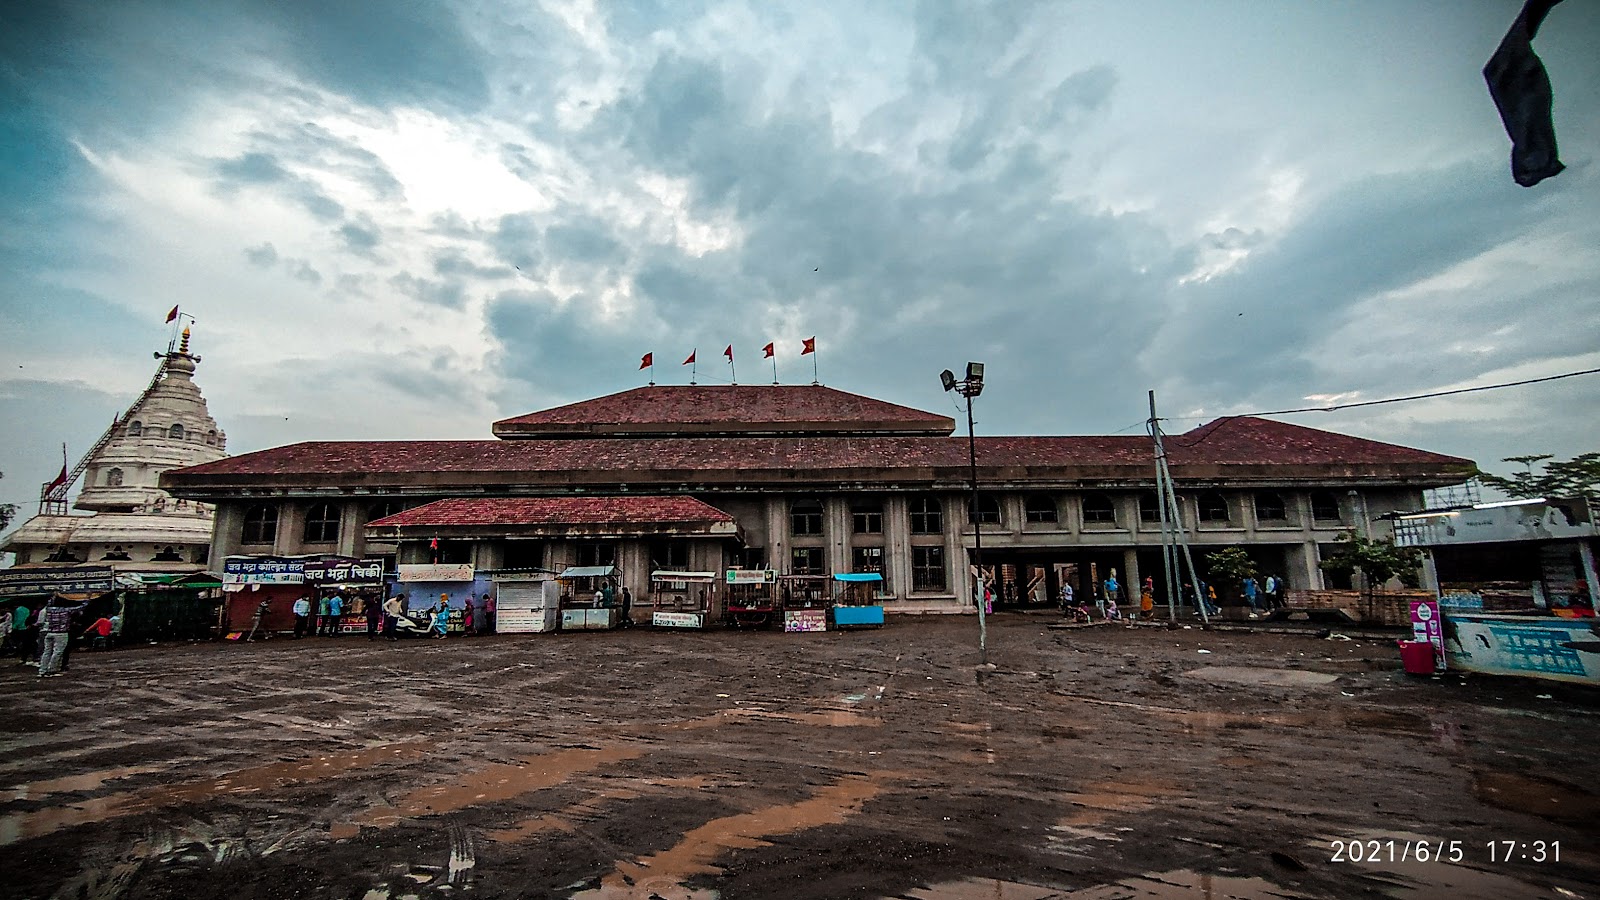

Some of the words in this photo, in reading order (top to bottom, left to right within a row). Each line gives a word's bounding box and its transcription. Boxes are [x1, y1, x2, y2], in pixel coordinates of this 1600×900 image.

[228, 563, 241, 571] जय
[86, 570, 112, 578] OUTSIDE
[304, 569, 325, 580] जय
[327, 568, 349, 581] भद्रा
[351, 564, 381, 578] चिक्की
